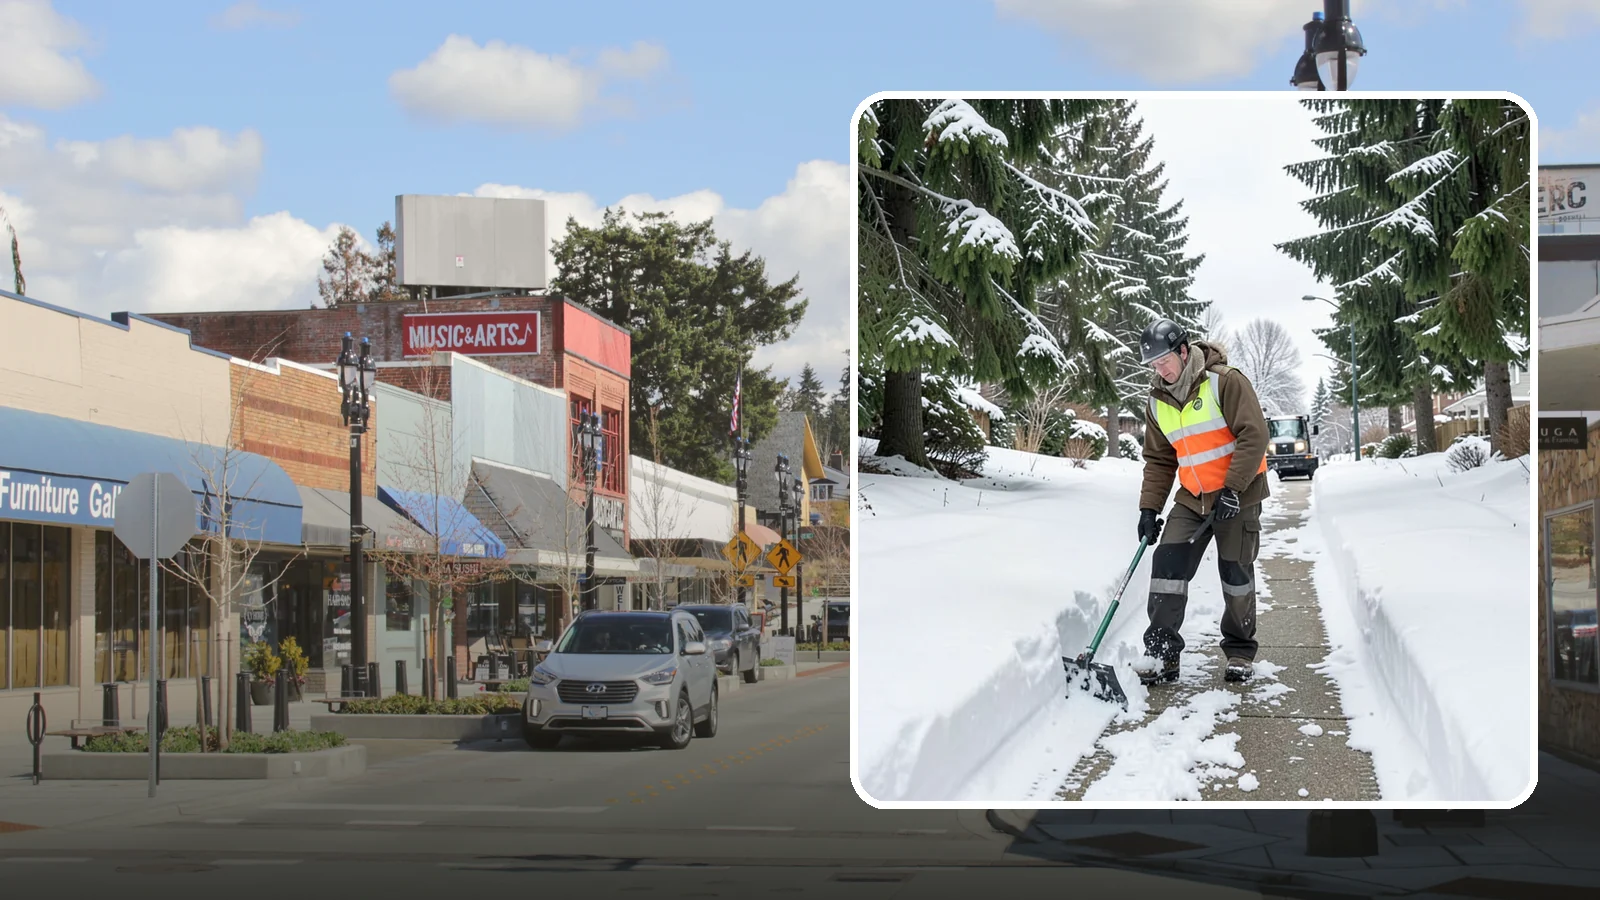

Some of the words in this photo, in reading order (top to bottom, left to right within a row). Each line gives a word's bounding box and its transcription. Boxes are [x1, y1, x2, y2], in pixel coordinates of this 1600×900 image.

[409, 322, 519, 349] MUSIC&ARTS
[0, 471, 79, 516] Furniture
[89, 482, 122, 519] Gal
[453, 563, 480, 575] SUSHI
